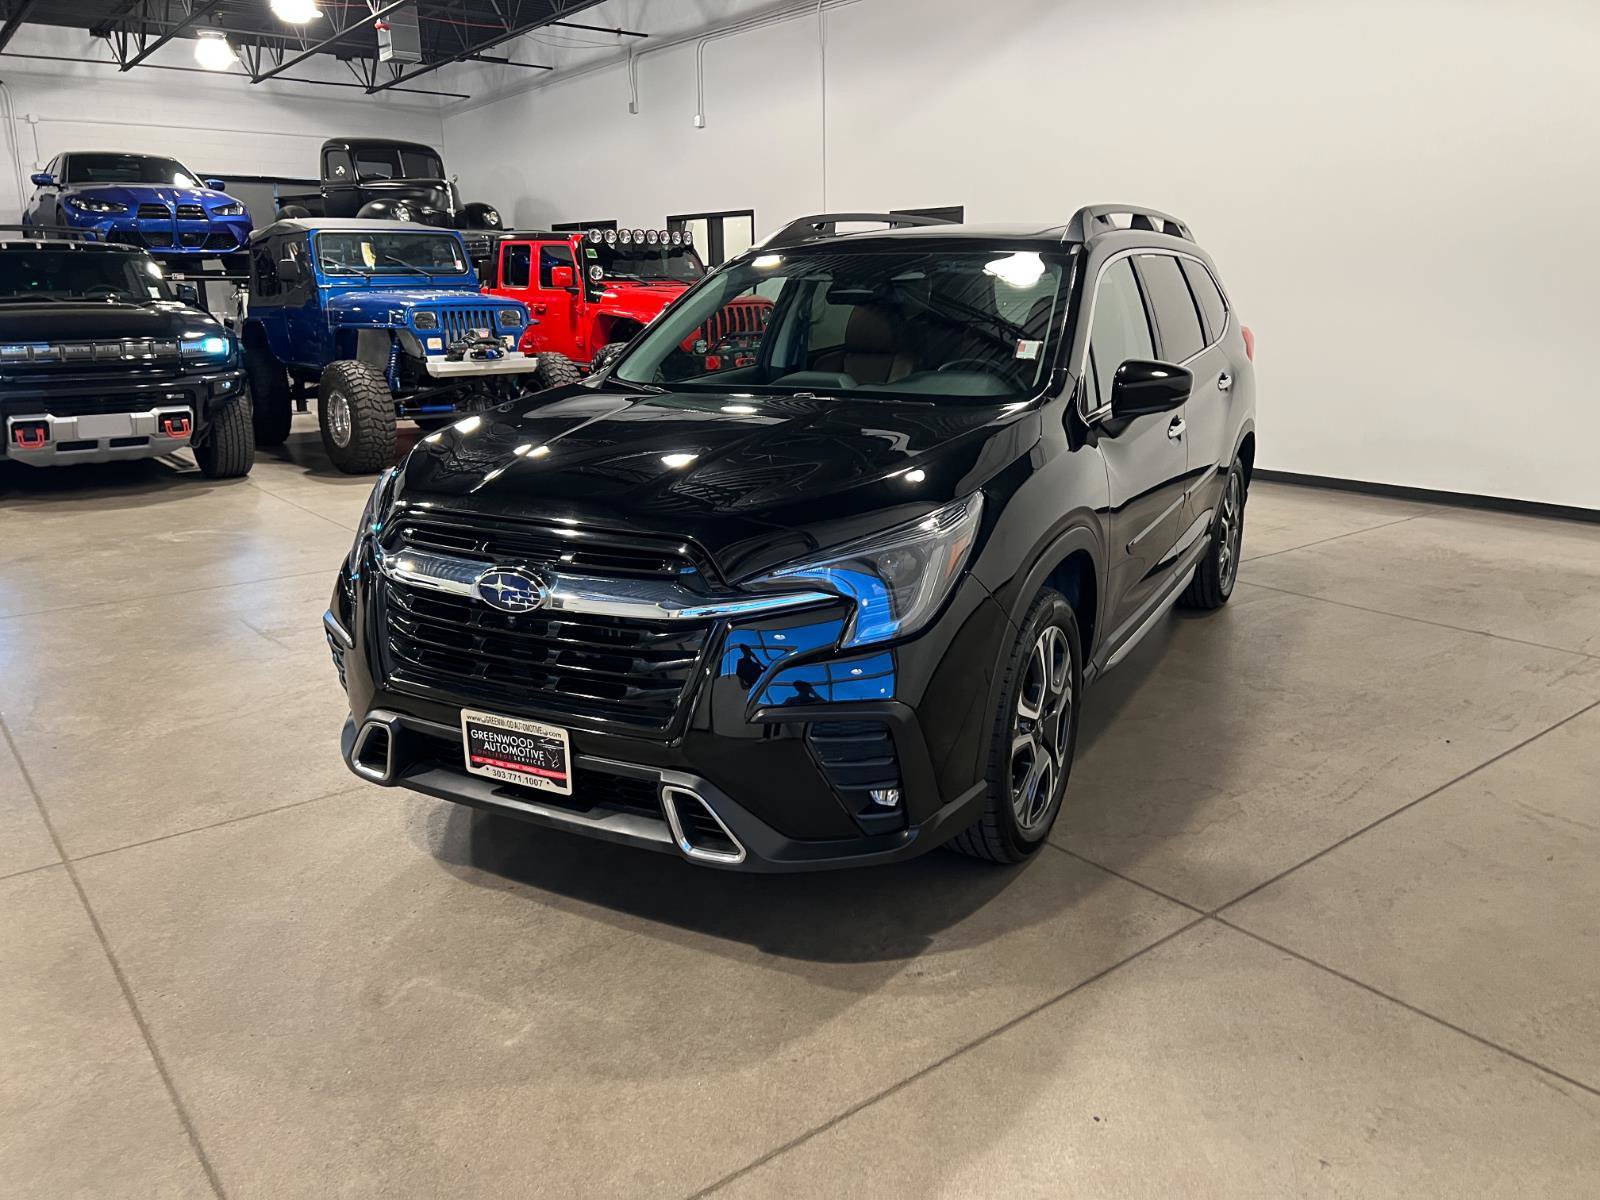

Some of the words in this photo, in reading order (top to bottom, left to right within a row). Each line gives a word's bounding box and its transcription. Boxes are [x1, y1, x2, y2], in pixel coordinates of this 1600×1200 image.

[470, 729, 534, 748] GREENWOOD
[483, 741, 545, 761] AUTOMOTIVE
[513, 757, 545, 767] SERVICES
[492, 770, 543, 787] 303.771.1007
